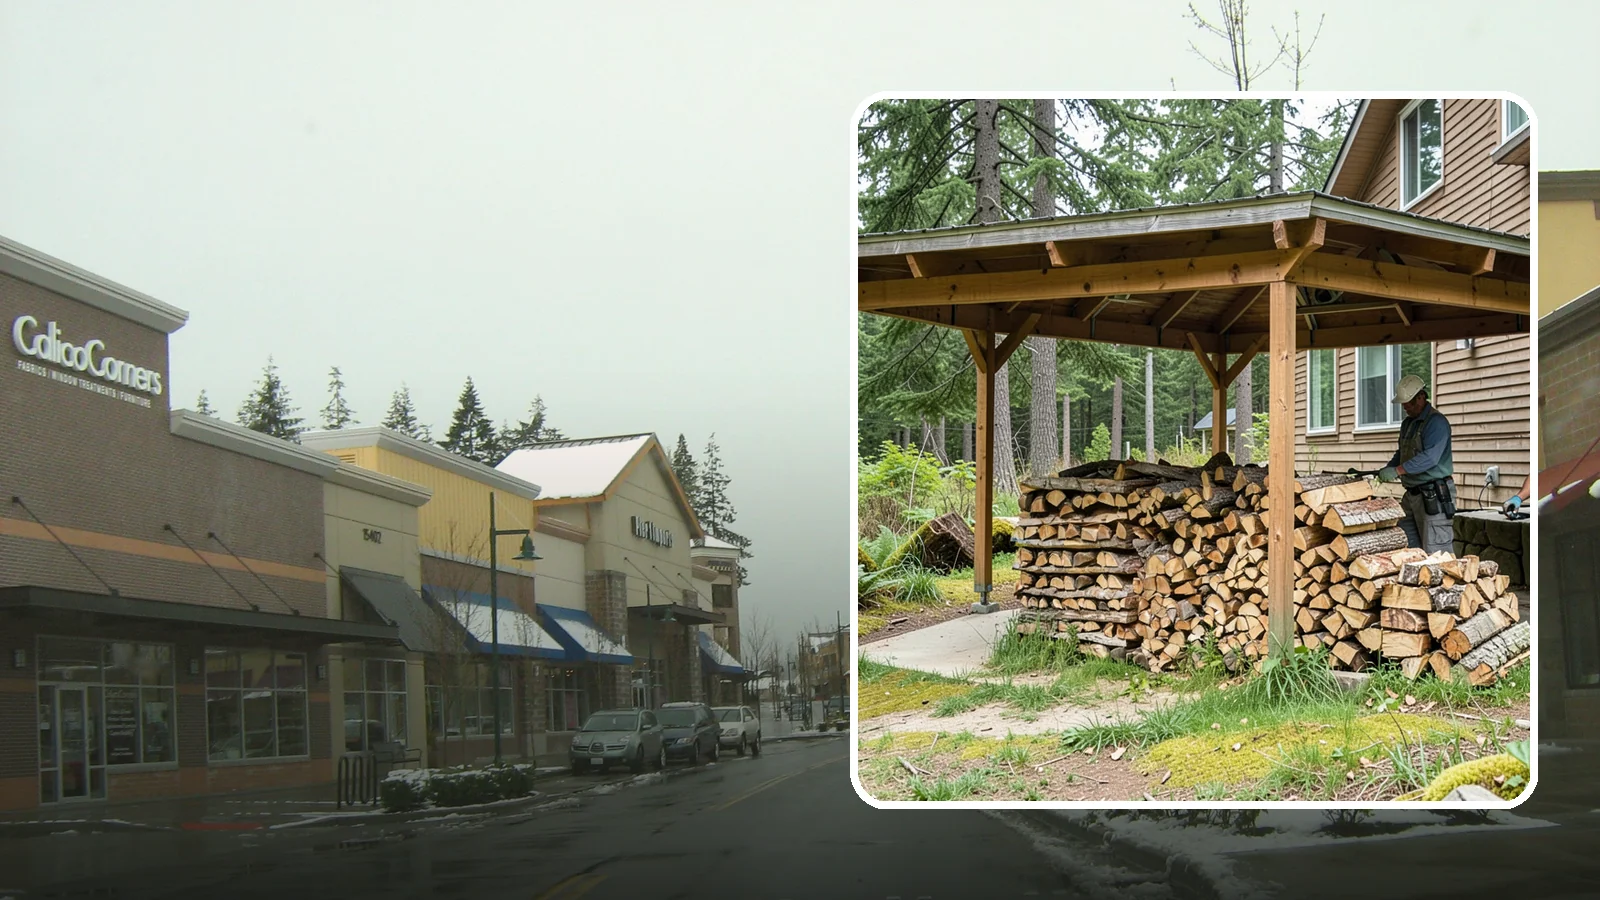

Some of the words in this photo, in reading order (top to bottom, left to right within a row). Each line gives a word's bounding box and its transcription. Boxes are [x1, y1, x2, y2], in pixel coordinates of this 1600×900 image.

[17, 360, 47, 377] FABRICS
[51, 371, 78, 386] WINDOW
[79, 379, 117, 398] TREATMENTS
[120, 391, 151, 408] FURNITURE
